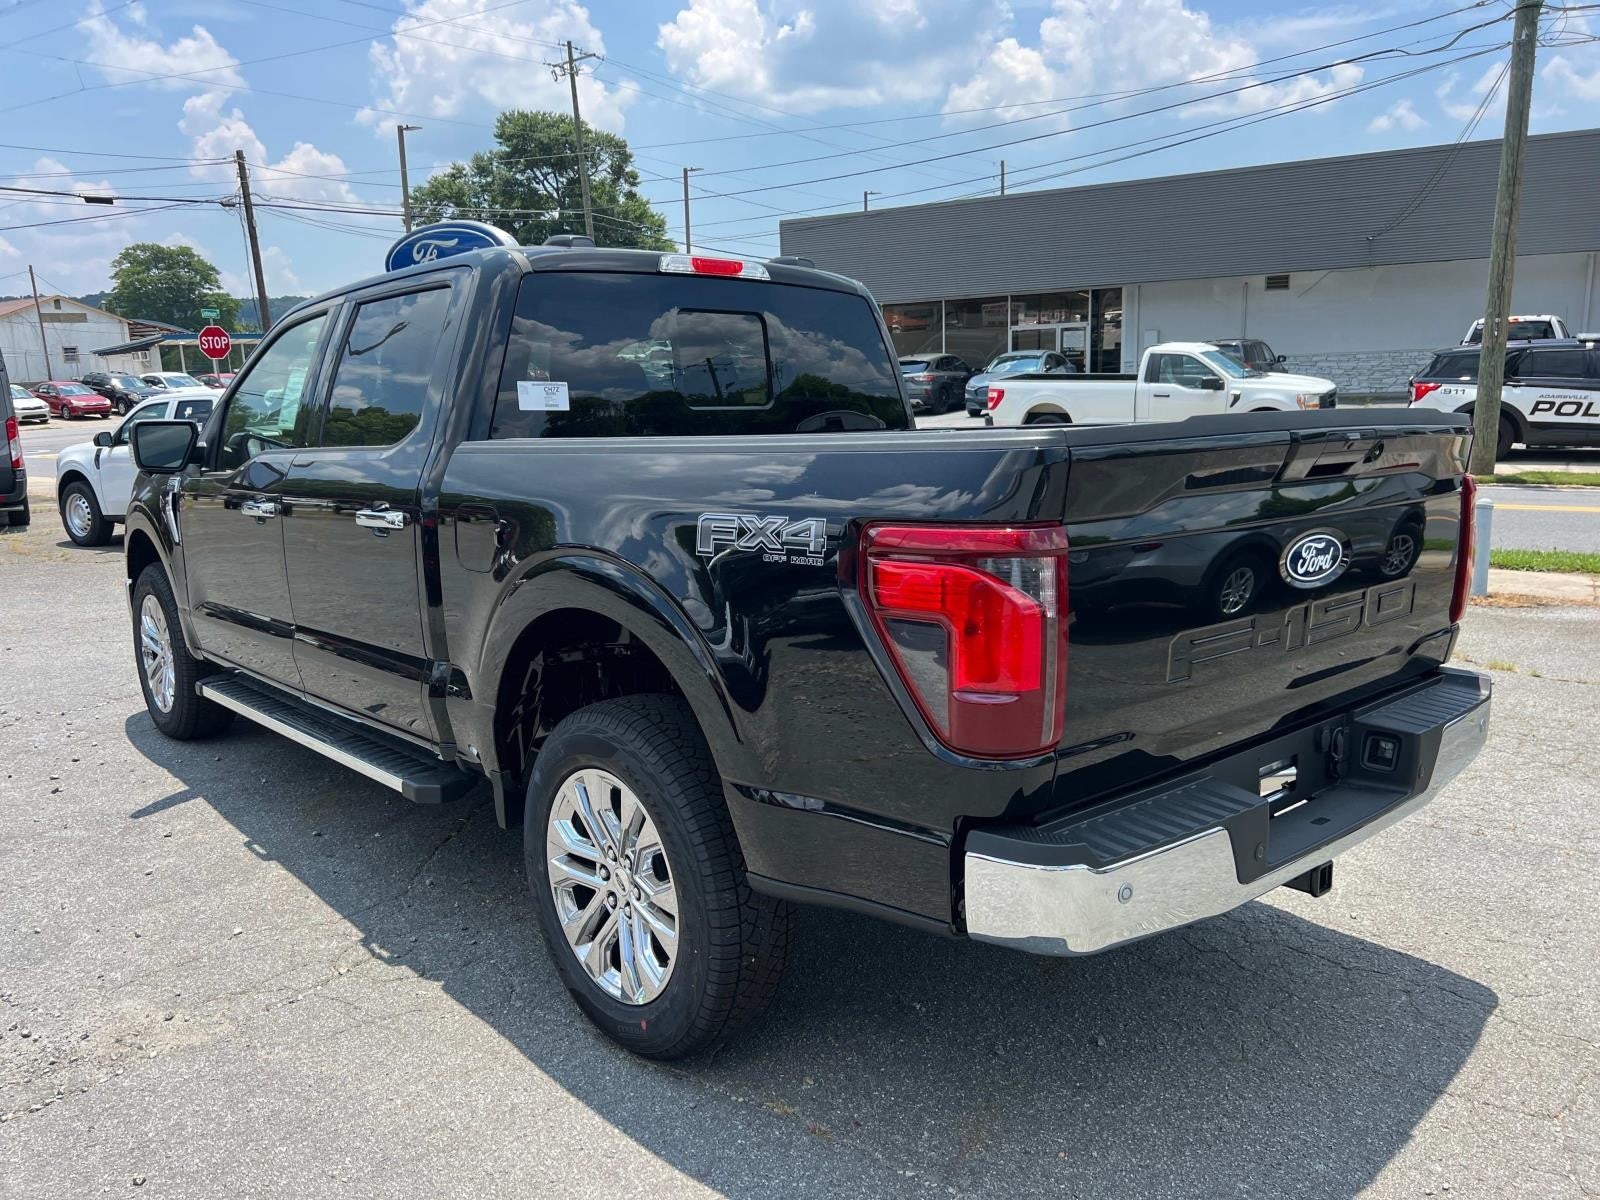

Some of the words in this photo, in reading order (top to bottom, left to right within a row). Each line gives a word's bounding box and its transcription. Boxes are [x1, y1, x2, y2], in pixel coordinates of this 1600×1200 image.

[201, 336, 228, 349] STOP
[1529, 400, 1600, 417] POL
[696, 512, 826, 556] FX4
[763, 553, 787, 562] OFF
[790, 556, 824, 566] ROAD
[1297, 541, 1334, 574] Ford
[1166, 577, 1417, 684] F-150
